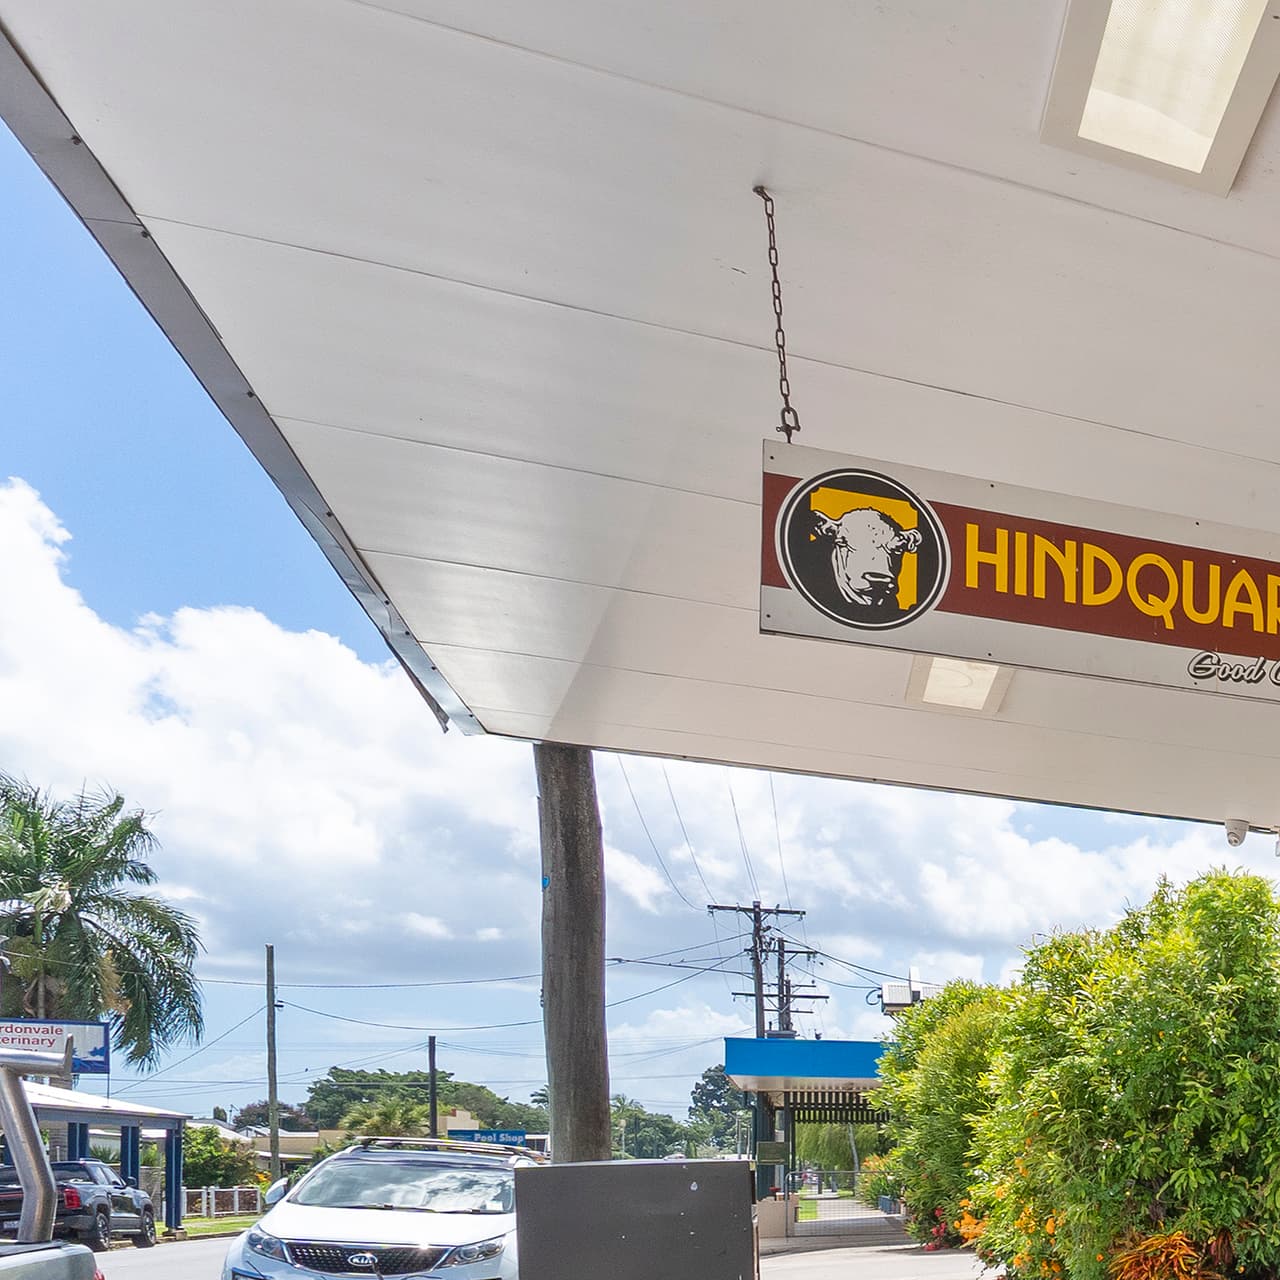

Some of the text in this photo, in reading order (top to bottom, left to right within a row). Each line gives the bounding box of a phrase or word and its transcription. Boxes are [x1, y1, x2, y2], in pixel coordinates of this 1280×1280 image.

[1187, 651, 1265, 683] Good
[0, 1035, 55, 1048] erinary
[474, 1133, 497, 1142] Pool
[500, 1133, 524, 1144] Shop
